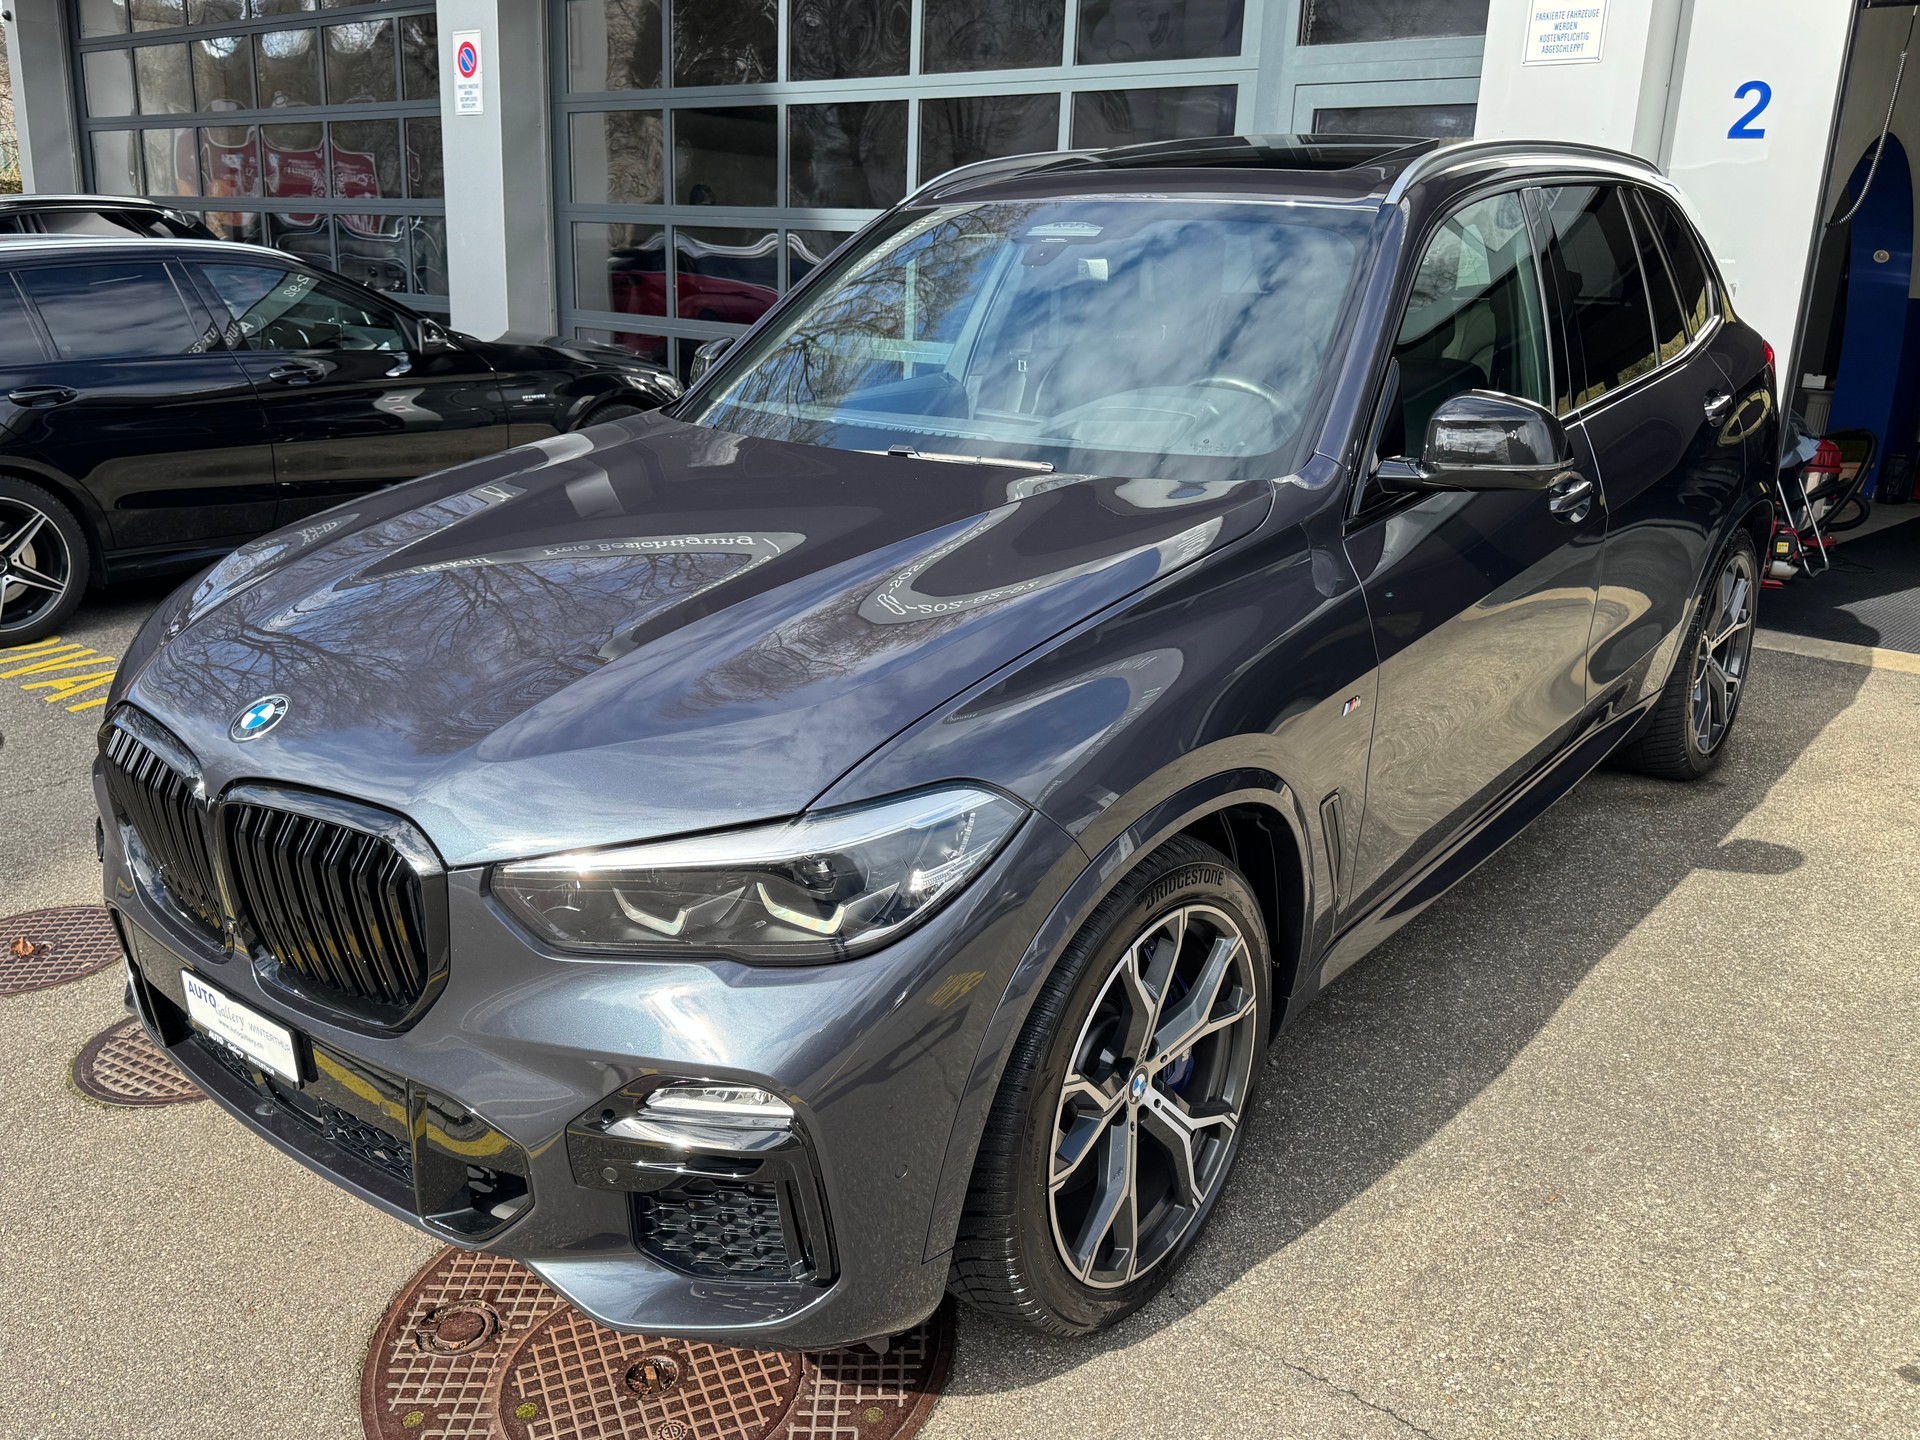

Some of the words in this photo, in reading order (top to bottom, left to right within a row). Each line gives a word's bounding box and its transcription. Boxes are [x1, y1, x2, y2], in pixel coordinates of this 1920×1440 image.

[1535, 11, 1566, 21] PARKIERTE
[1567, 8, 1600, 19] FAHRZEUGE
[1554, 21, 1578, 31] WERDEN
[1539, 32, 1590, 43] KOSTENPFLICHTIG
[1541, 43, 1584, 54] ABGESCHLEPPT
[1727, 80, 1772, 139] 2
[1145, 868, 1224, 911] BRIDGESTONE
[188, 980, 217, 1009] AUTO
[248, 1022, 292, 1054] WINTERTHUR
